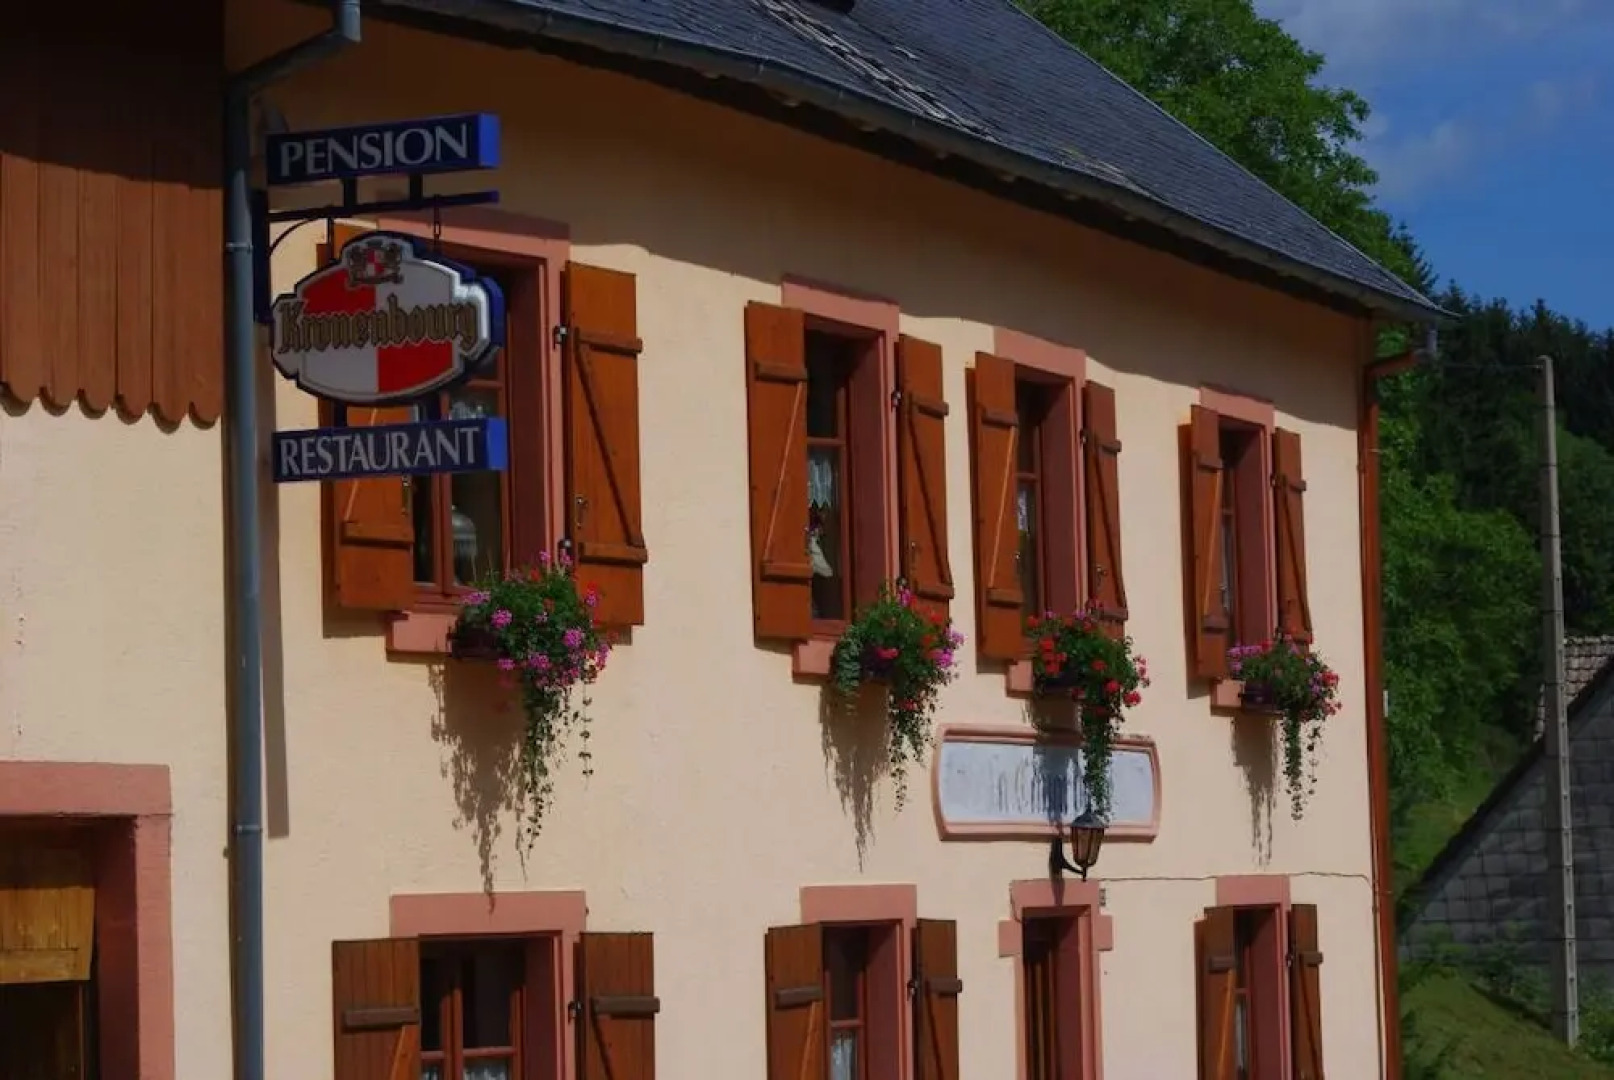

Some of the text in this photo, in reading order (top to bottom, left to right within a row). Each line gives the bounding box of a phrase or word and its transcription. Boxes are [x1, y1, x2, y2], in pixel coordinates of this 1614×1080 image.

[280, 122, 468, 177] PENSION
[278, 293, 478, 354] Kronenbourg
[279, 427, 480, 476] RESTAURANT
